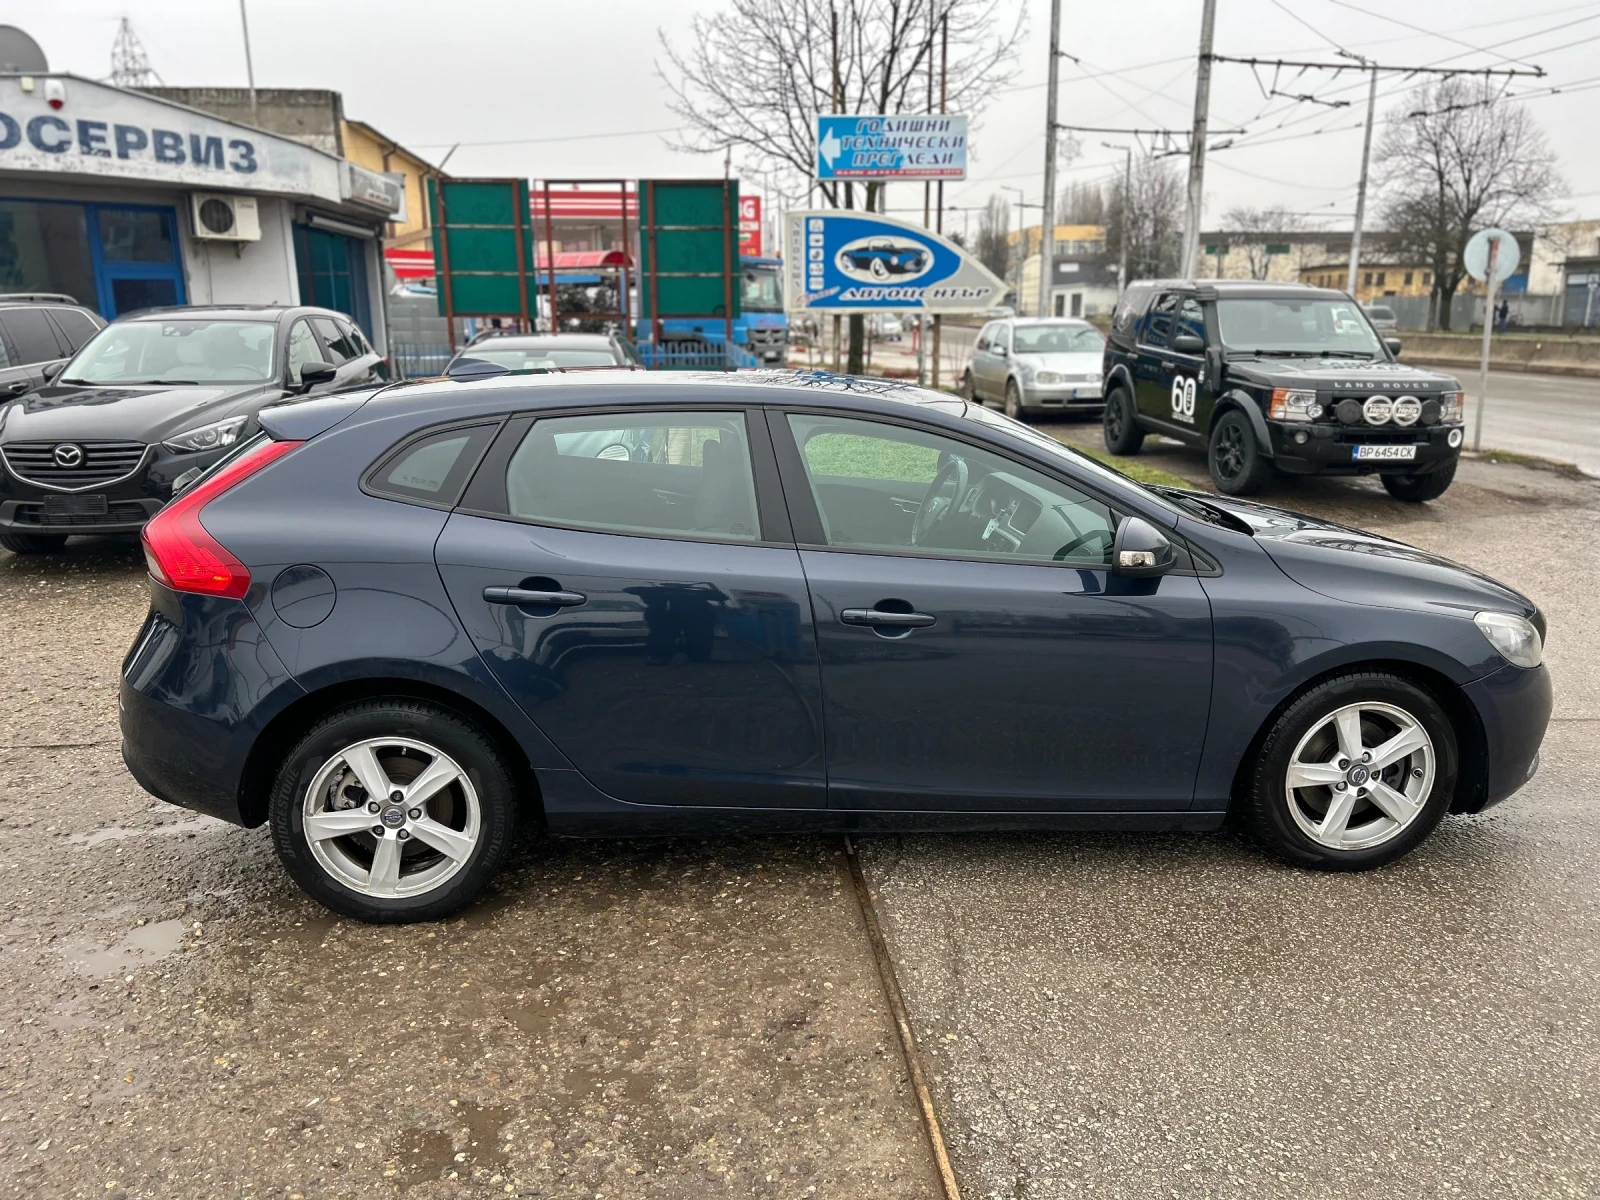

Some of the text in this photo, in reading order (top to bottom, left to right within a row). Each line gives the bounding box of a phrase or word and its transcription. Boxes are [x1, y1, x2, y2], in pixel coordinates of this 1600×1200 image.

[857, 120, 950, 133] ГОДИШНИ
[842, 136, 965, 149] ТЕХНИЧЕСКИ
[853, 152, 954, 166] ПРЕГЛЕДИ
[843, 286, 992, 301] АВТОЦЕНТЪР
[1172, 375, 1196, 416] 60
[1369, 406, 1390, 414] Hella
[1397, 406, 1418, 414] Hella
[1359, 447, 1414, 458] BP 6454 CK
[278, 766, 299, 859] BRIDGESTONE
